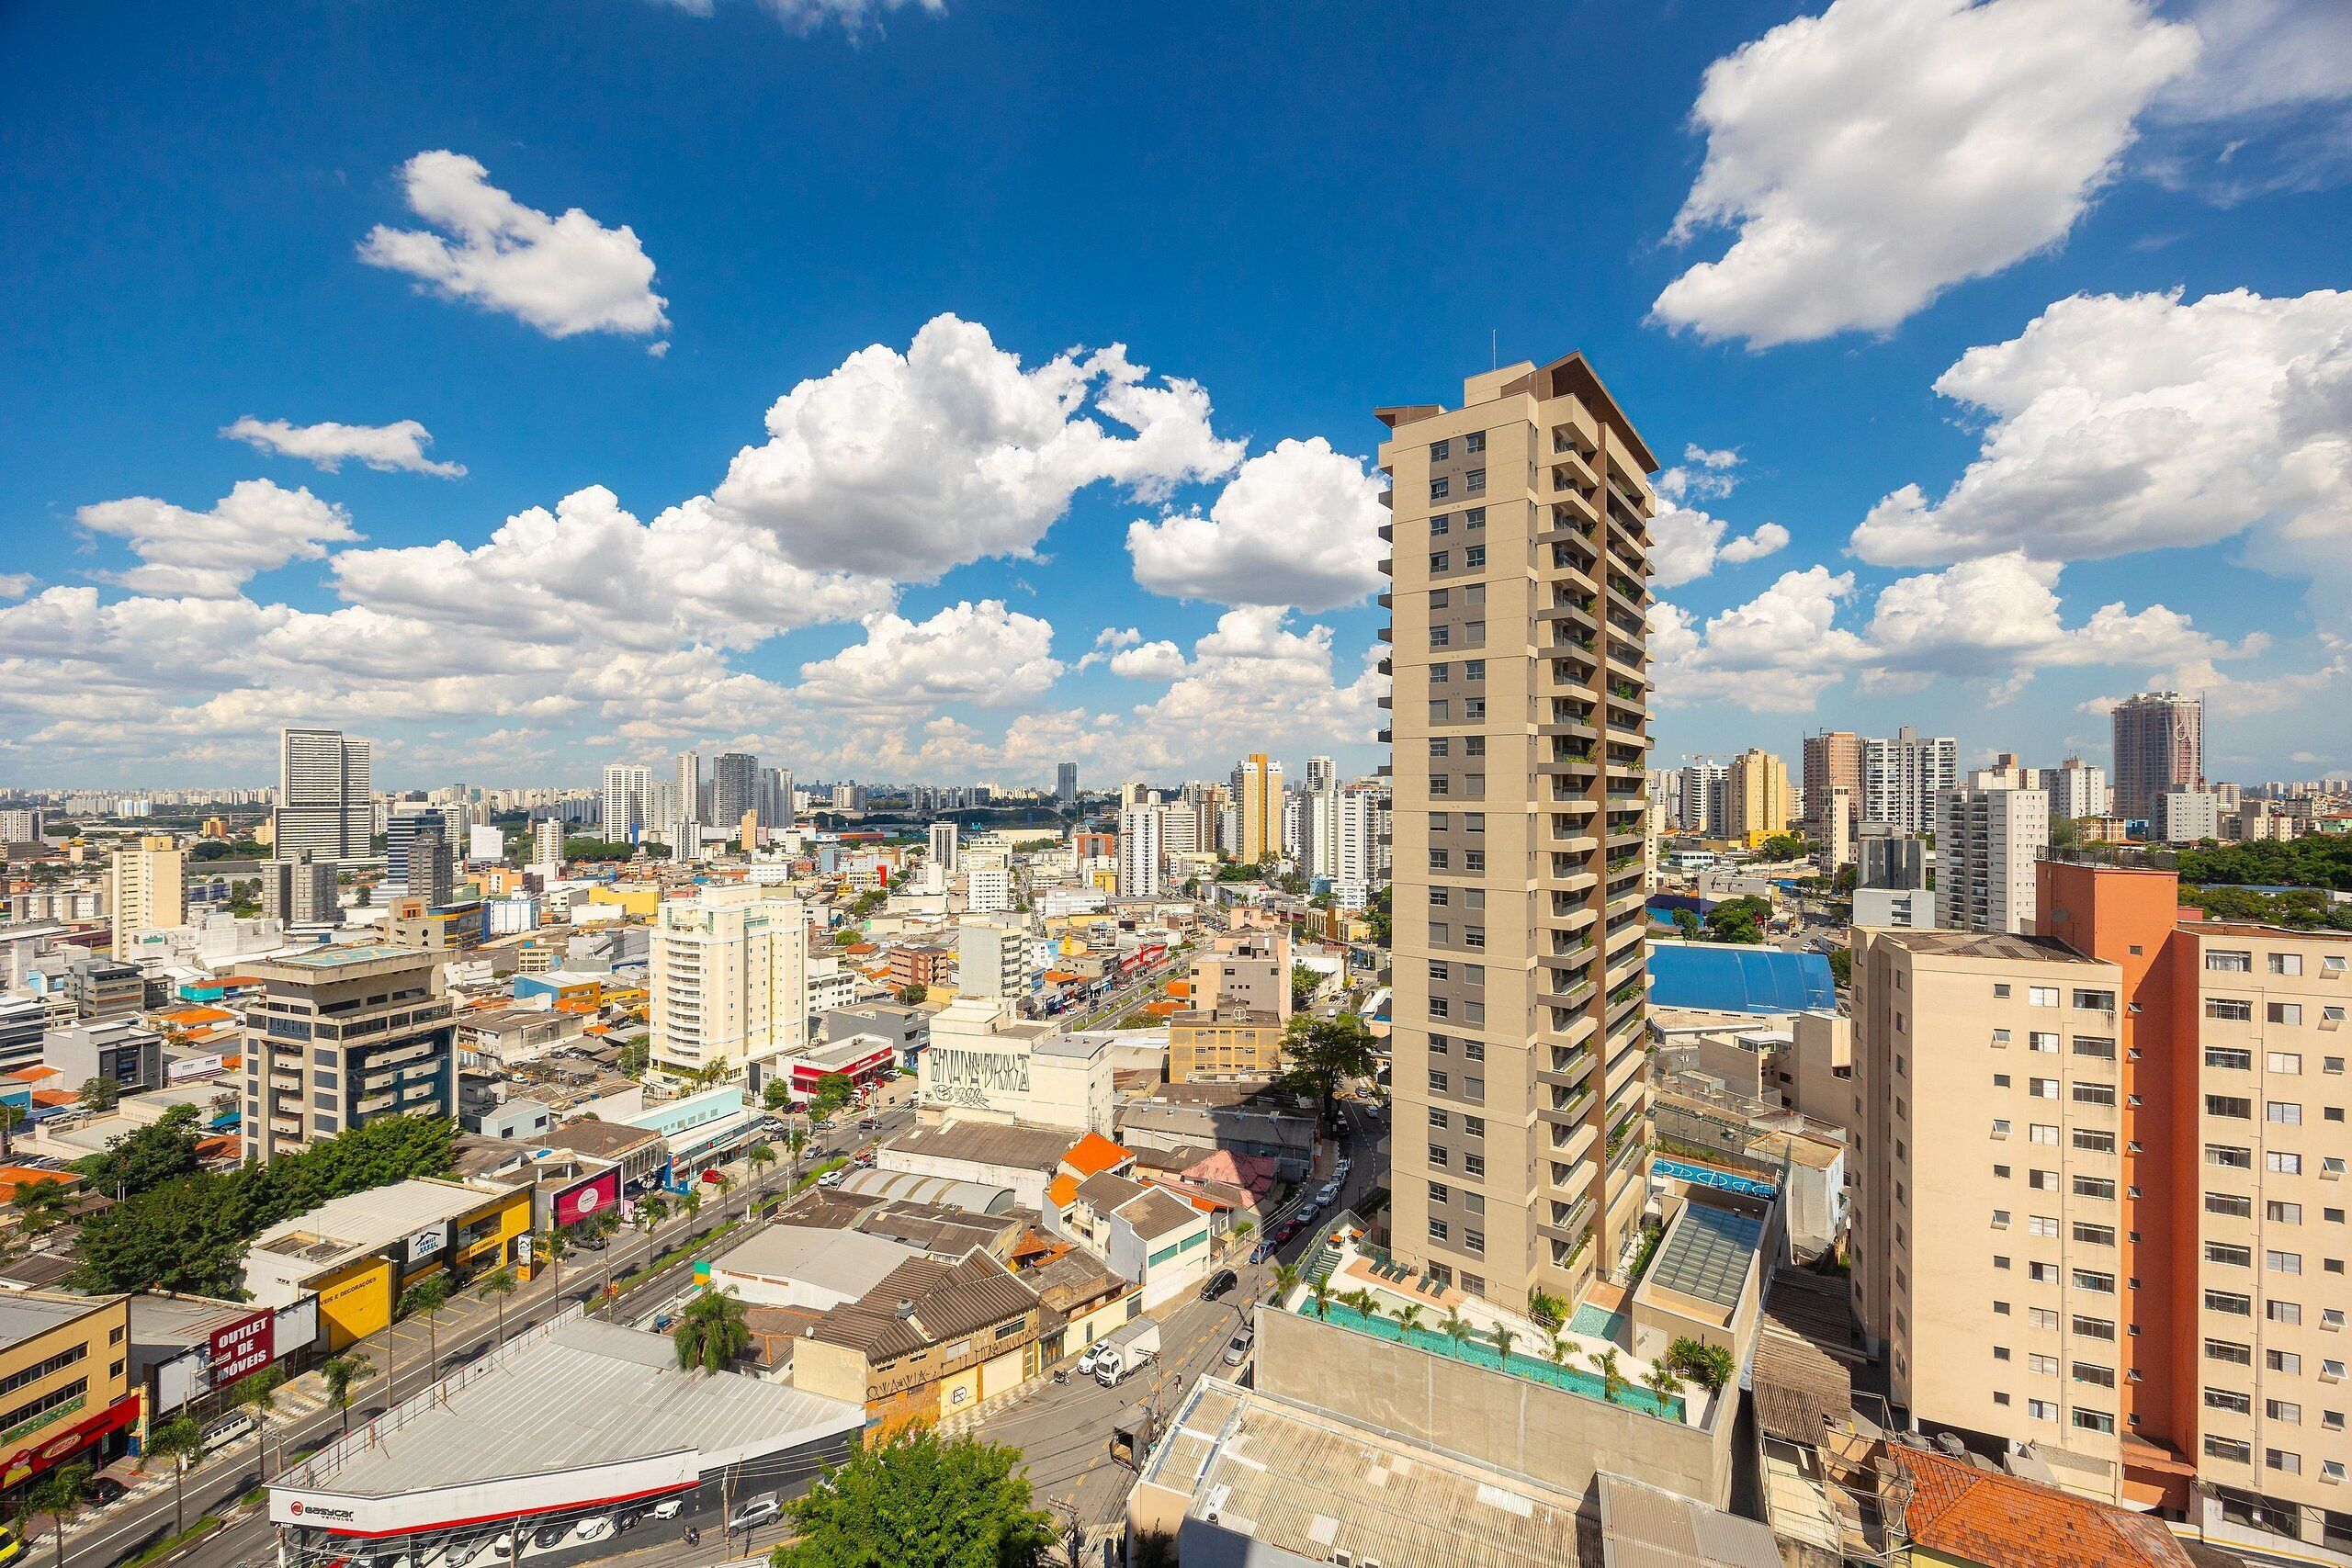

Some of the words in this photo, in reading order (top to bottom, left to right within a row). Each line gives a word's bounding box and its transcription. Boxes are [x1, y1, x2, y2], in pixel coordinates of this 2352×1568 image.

[219, 1316, 268, 1348] OUTLET
[237, 1338, 254, 1357] DE
[217, 1349, 266, 1382] MÓVEIS
[305, 1506, 354, 1518] easycar
